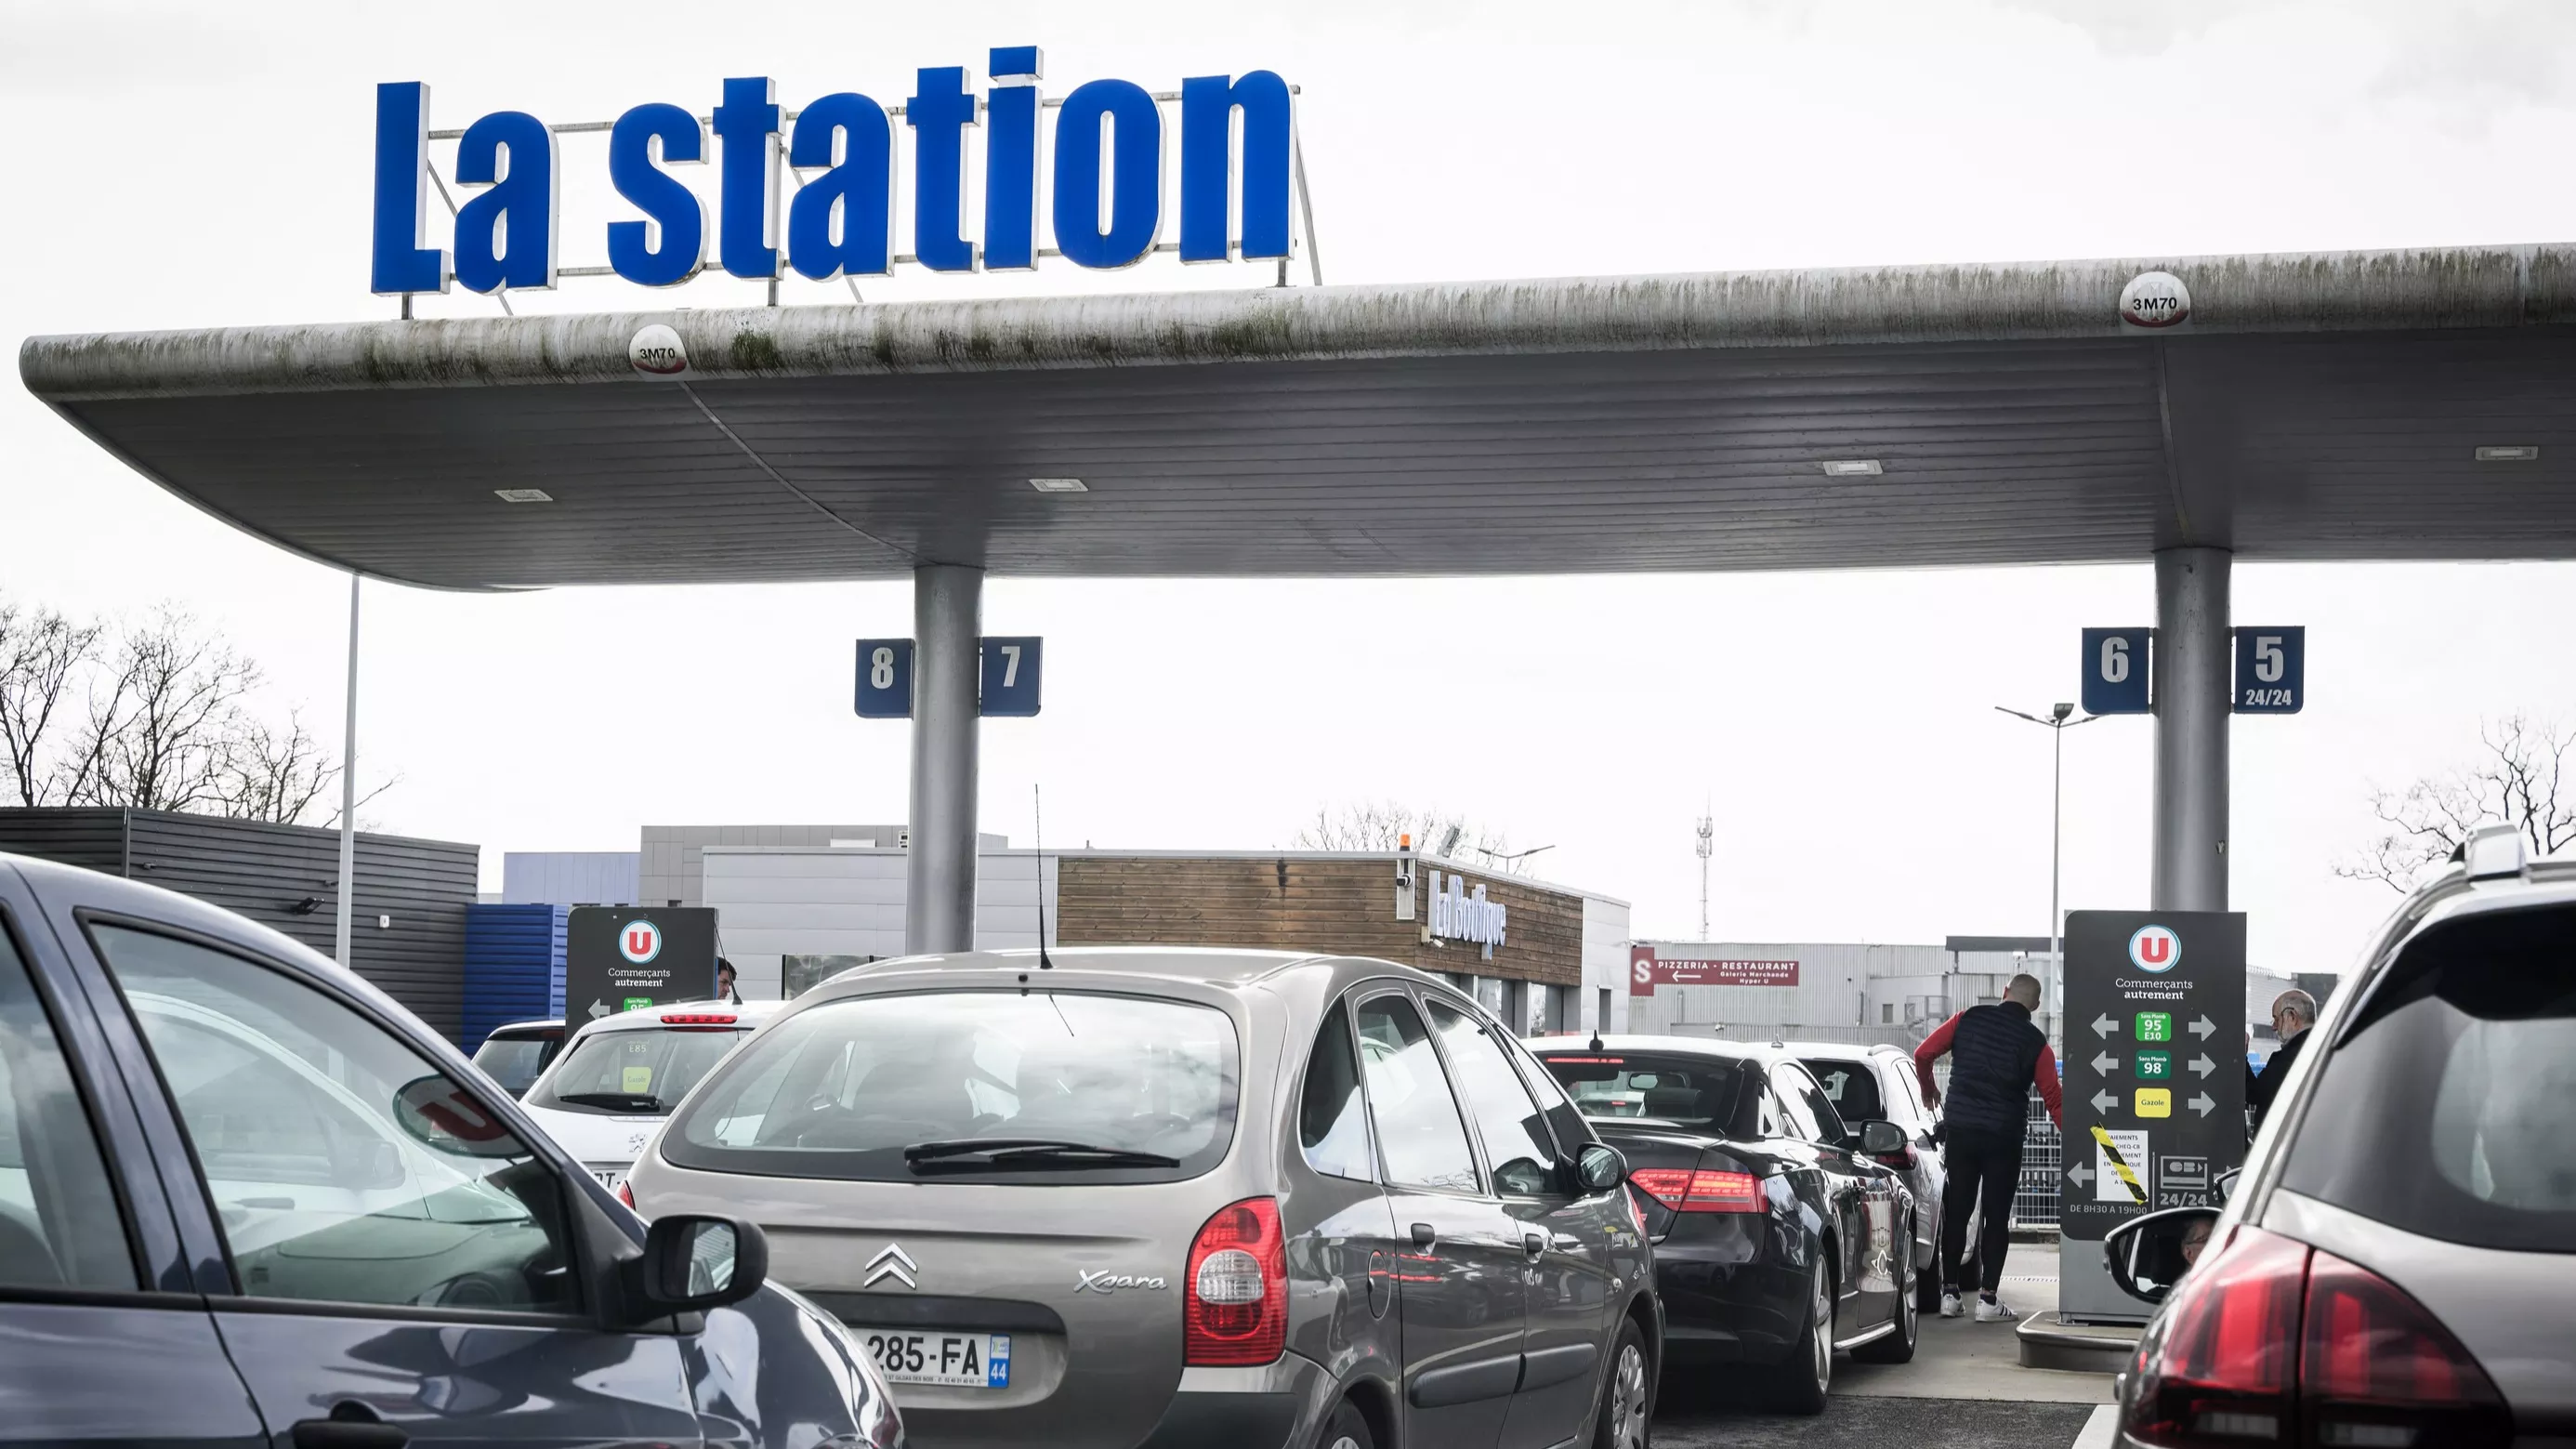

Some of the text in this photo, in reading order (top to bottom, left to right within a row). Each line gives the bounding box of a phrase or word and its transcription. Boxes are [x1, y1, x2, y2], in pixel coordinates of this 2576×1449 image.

[372, 46, 1294, 296] La station
[2133, 297, 2177, 310] 3M70
[639, 348, 676, 360] 3M70
[1001, 646, 1020, 687] 7
[2101, 637, 2129, 683] 6
[2255, 636, 2284, 682] 5
[871, 647, 894, 690] 8
[2245, 689, 2293, 706] 24/24
[628, 931, 651, 955] U
[2141, 937, 2169, 963] U
[608, 968, 671, 979] Commerçants
[1635, 959, 1651, 983] S
[1658, 961, 1709, 969] PIZZERIA
[1722, 962, 1795, 970] RESTAURANT
[614, 979, 664, 987] autrement
[2115, 978, 2193, 991] Commerçants
[2123, 990, 2184, 1000] autrement
[2144, 1020, 2162, 1031] 95
[2144, 1032, 2162, 1040] E10
[628, 1045, 647, 1053] E85
[2144, 1062, 2162, 1074] 98
[2160, 1192, 2208, 1208] 24/24
[2083, 1205, 2108, 1213] 8H30
[2119, 1205, 2148, 1215] 19H00
[1073, 1269, 1167, 1294] Xsara
[867, 1335, 979, 1376] 285-FA
[991, 1363, 1006, 1380] 44
